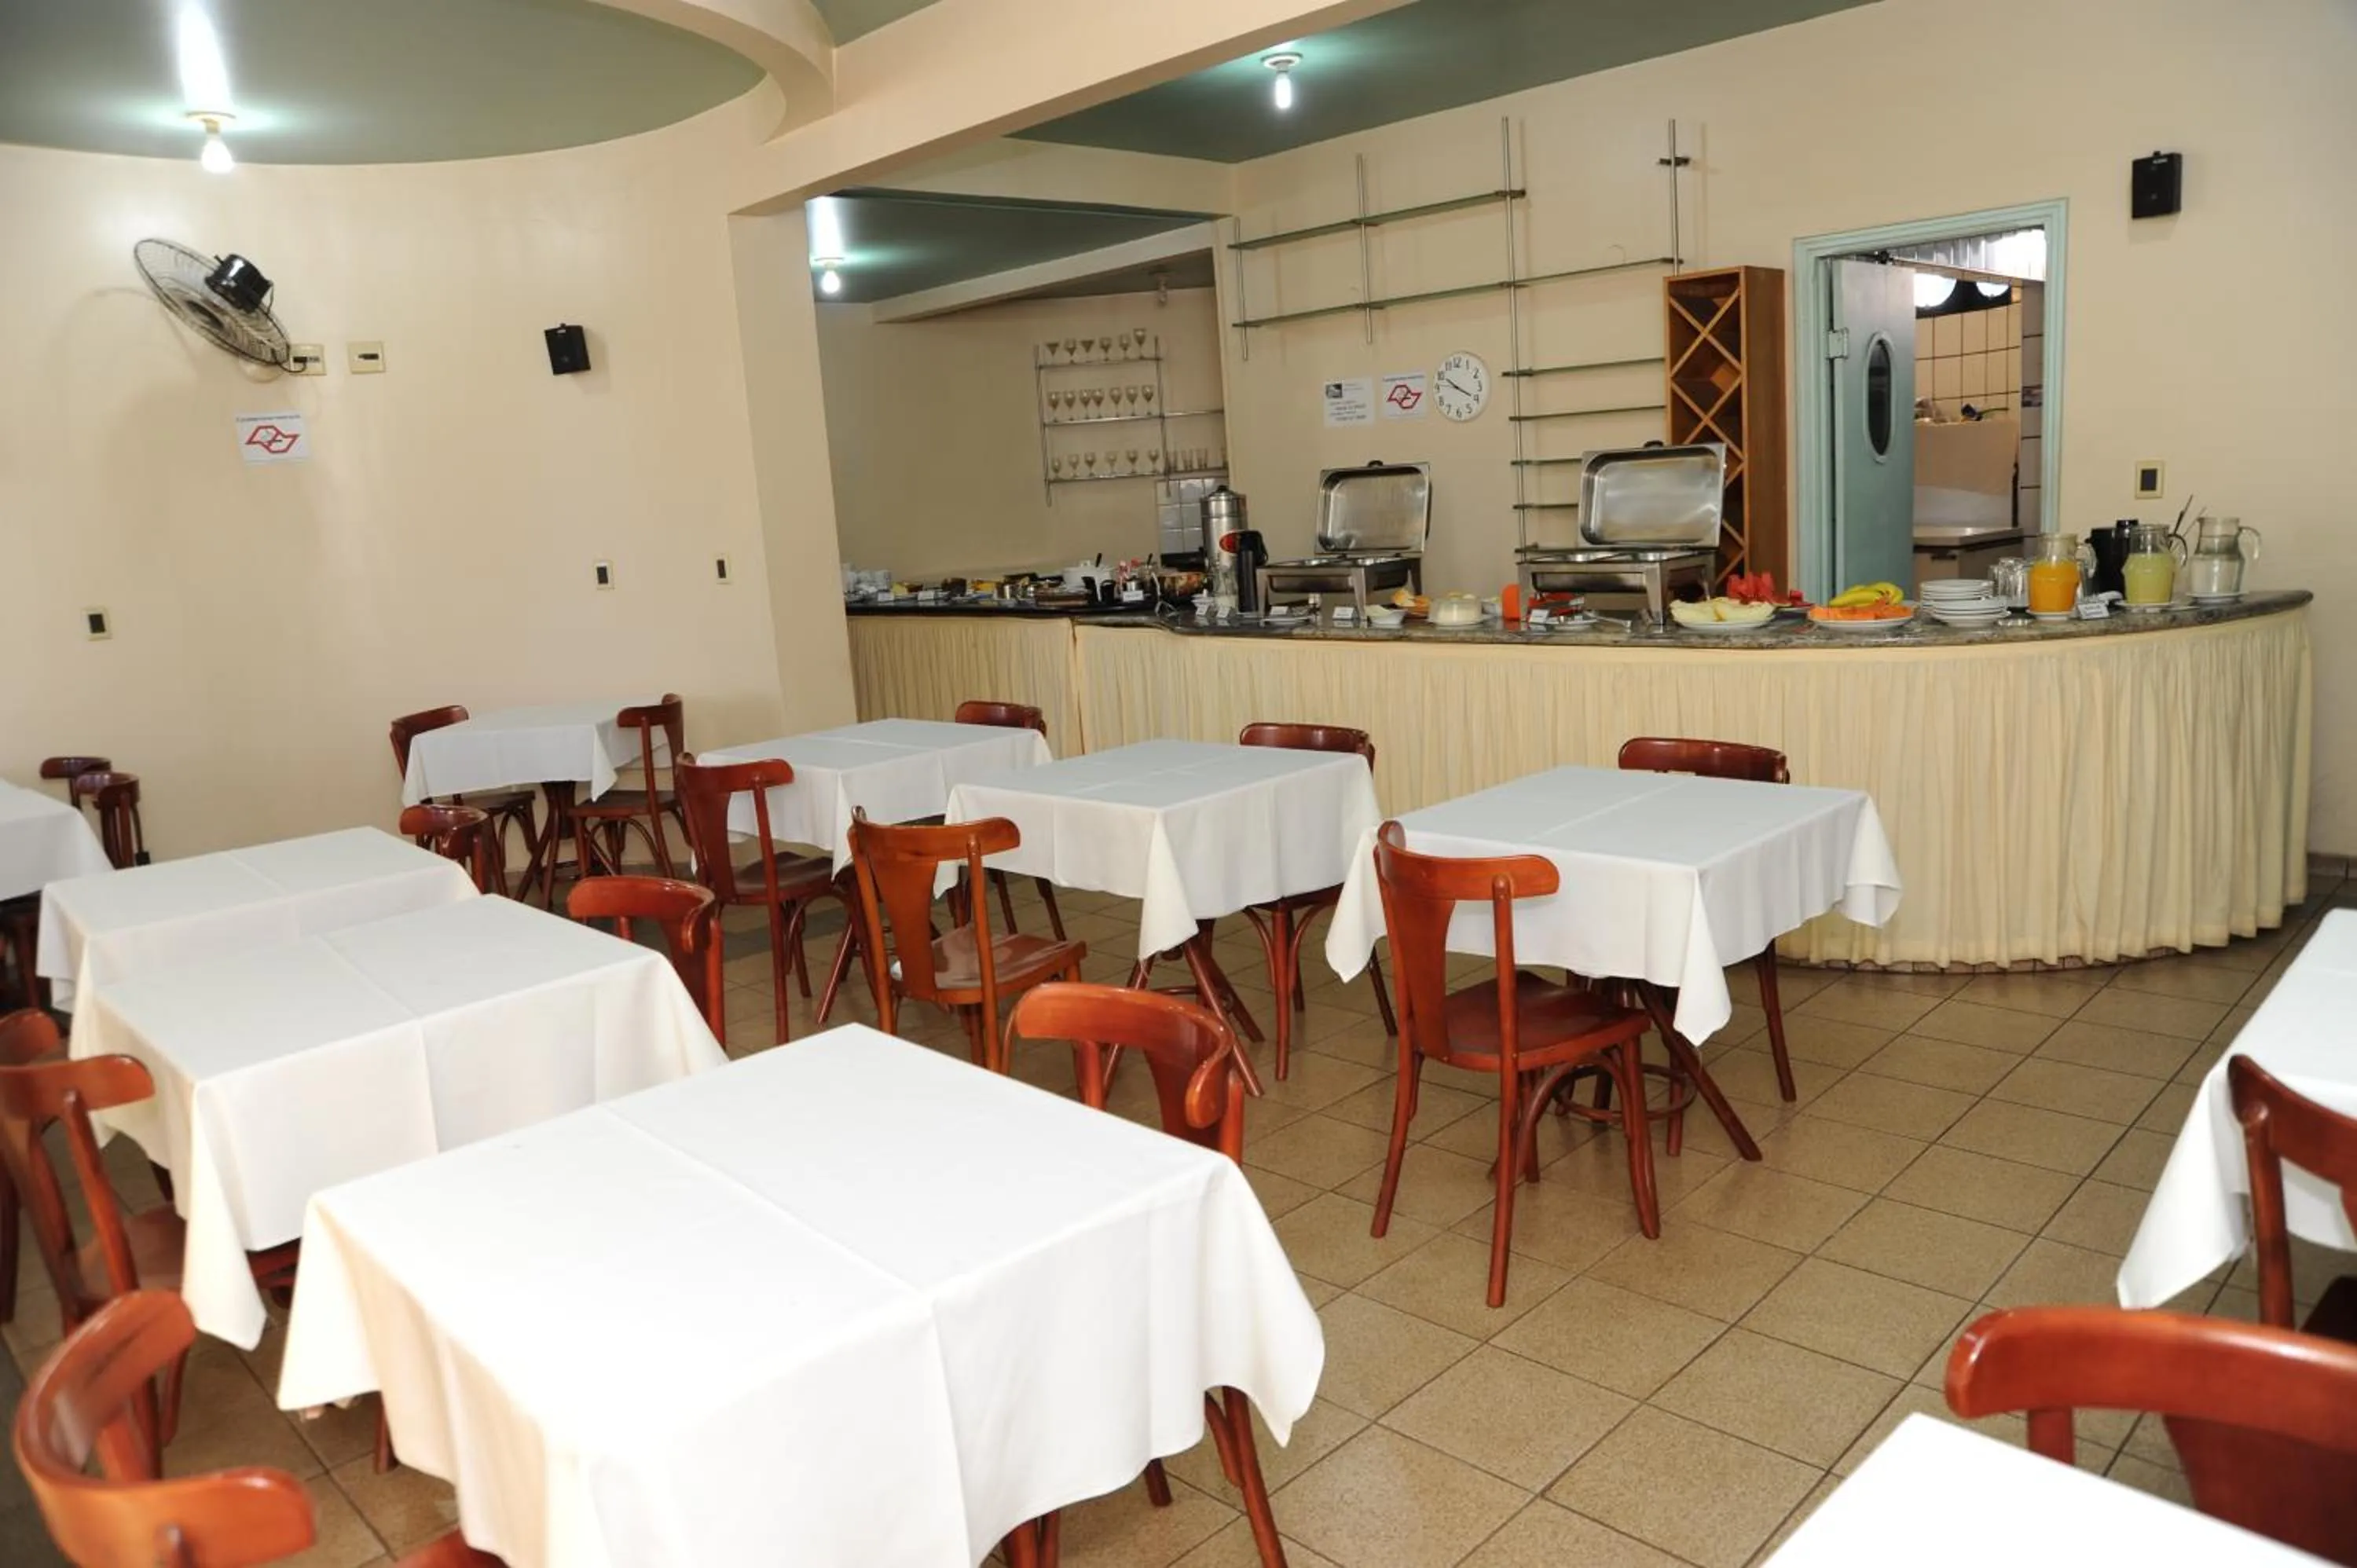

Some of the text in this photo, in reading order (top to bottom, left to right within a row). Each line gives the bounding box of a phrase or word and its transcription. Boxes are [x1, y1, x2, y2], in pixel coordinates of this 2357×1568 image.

[1453, 357, 1461, 368] 12
[1473, 367, 1479, 379] 2
[1477, 380, 1482, 391] 3
[1473, 394, 1479, 404] 4
[1445, 403, 1451, 415] 7
[1456, 408, 1462, 418] 6
[1465, 403, 1472, 414] 5
